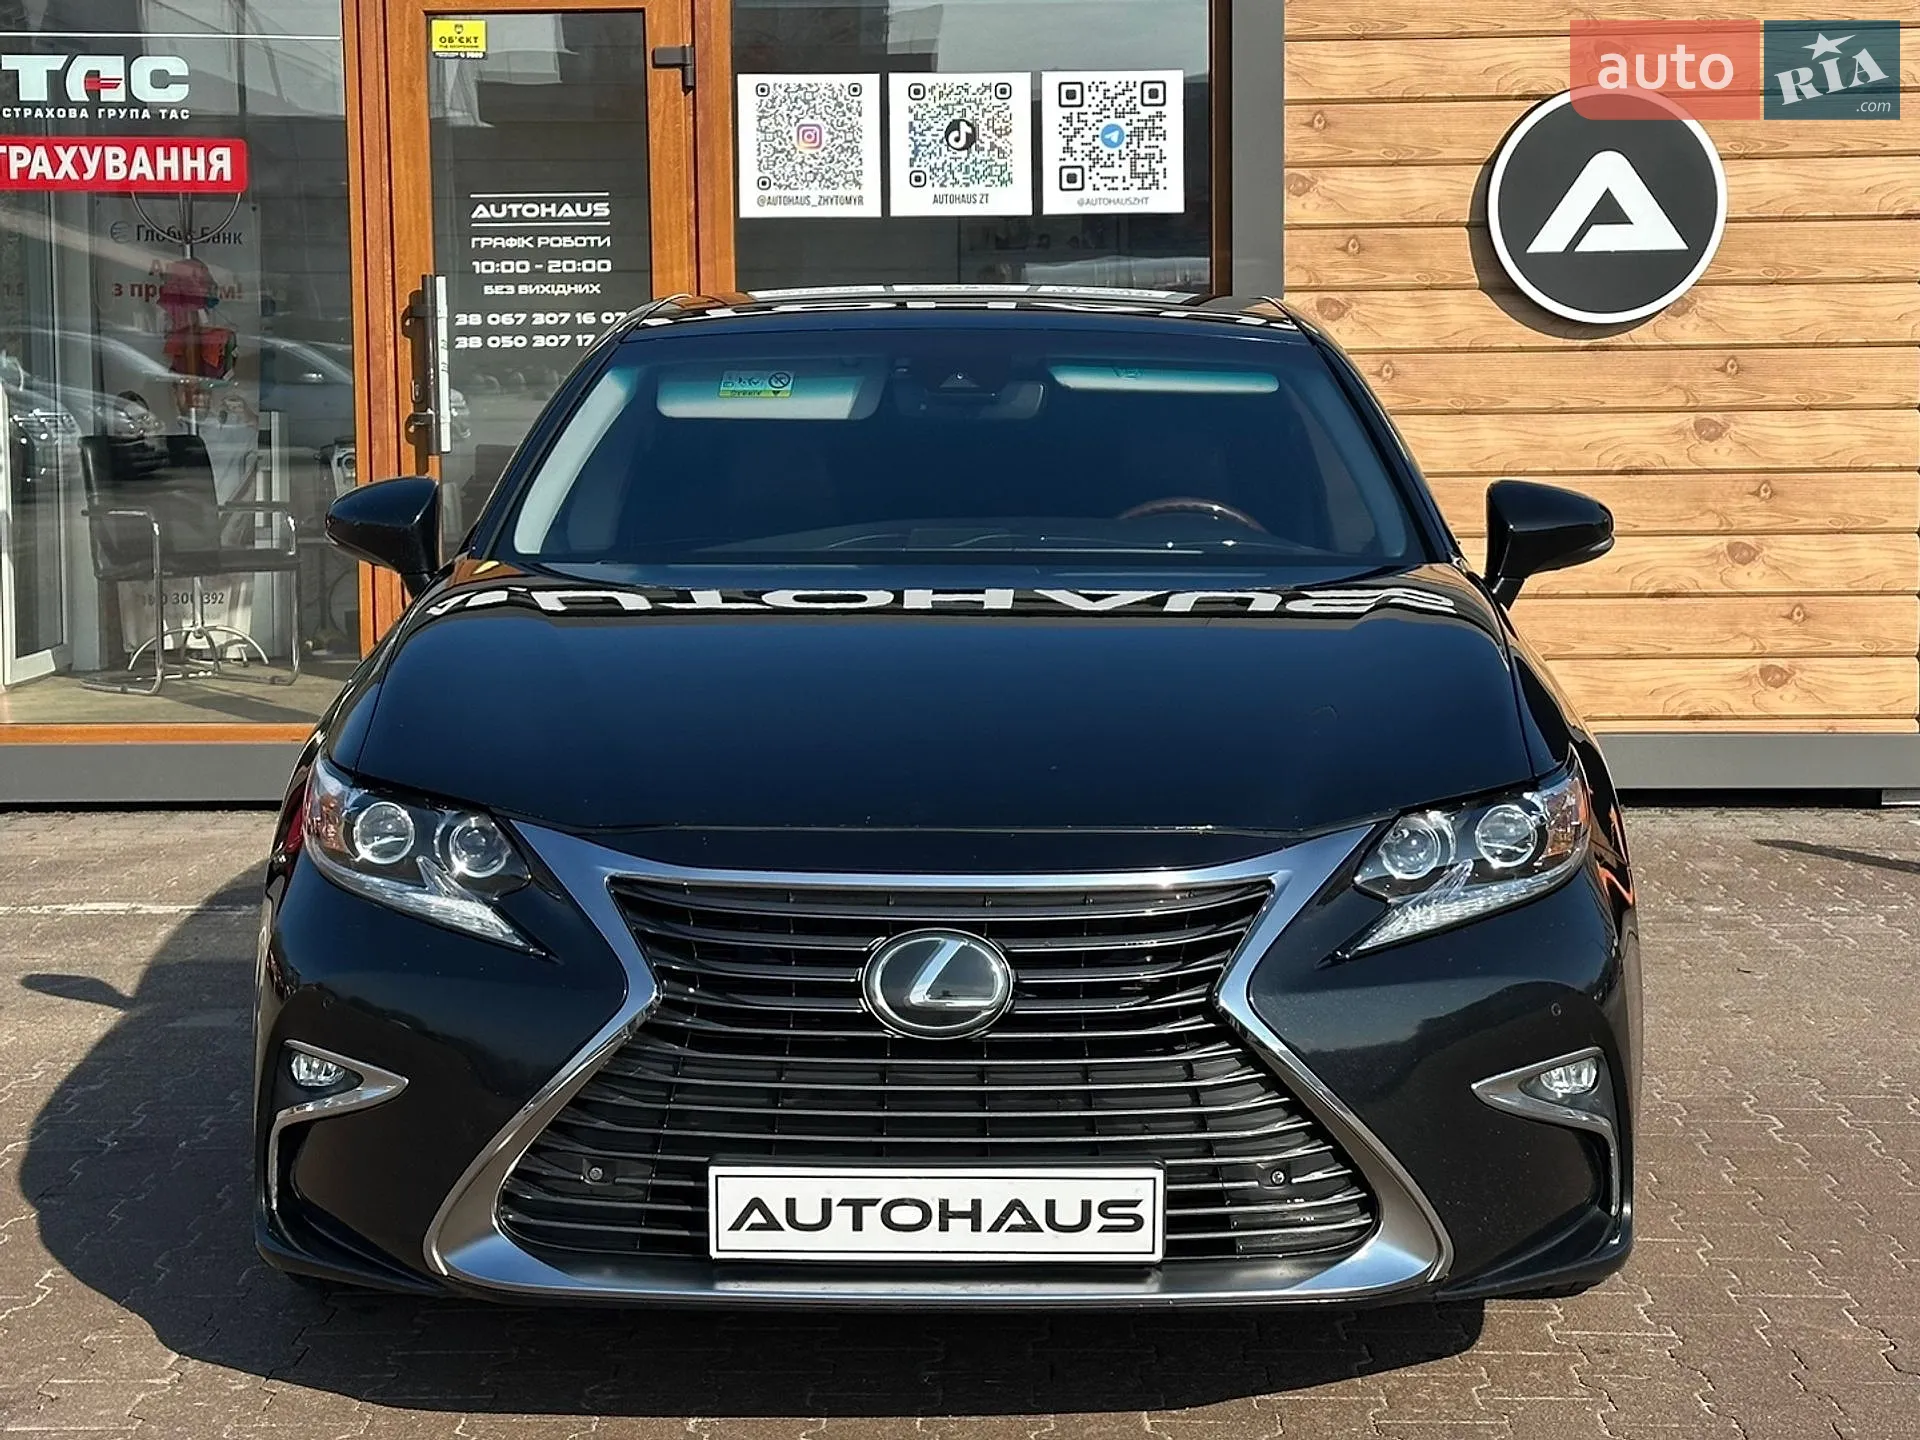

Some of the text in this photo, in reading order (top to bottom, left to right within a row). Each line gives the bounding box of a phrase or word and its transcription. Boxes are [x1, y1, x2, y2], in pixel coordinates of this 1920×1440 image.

[2, 108, 190, 120] СТРАХОВА ГРУПА ТАС
[0, 146, 232, 181] РАХУВАННЯ
[932, 193, 990, 205] AUTOHAUS ZT
[471, 202, 611, 219] AUTOHAUS
[471, 235, 611, 249] ГРАФІК РОБОТИ
[471, 259, 531, 274] 10:00
[547, 258, 612, 273] 20:00
[483, 283, 602, 296] БЕЗ ВИХІДНИХ
[454, 313, 483, 326] 38
[487, 312, 528, 326] 067
[531, 312, 572, 325] 307
[575, 311, 597, 325] 16
[454, 334, 596, 349] 38 050 307 17
[727, 1196, 1145, 1233] AUTOHAUS
